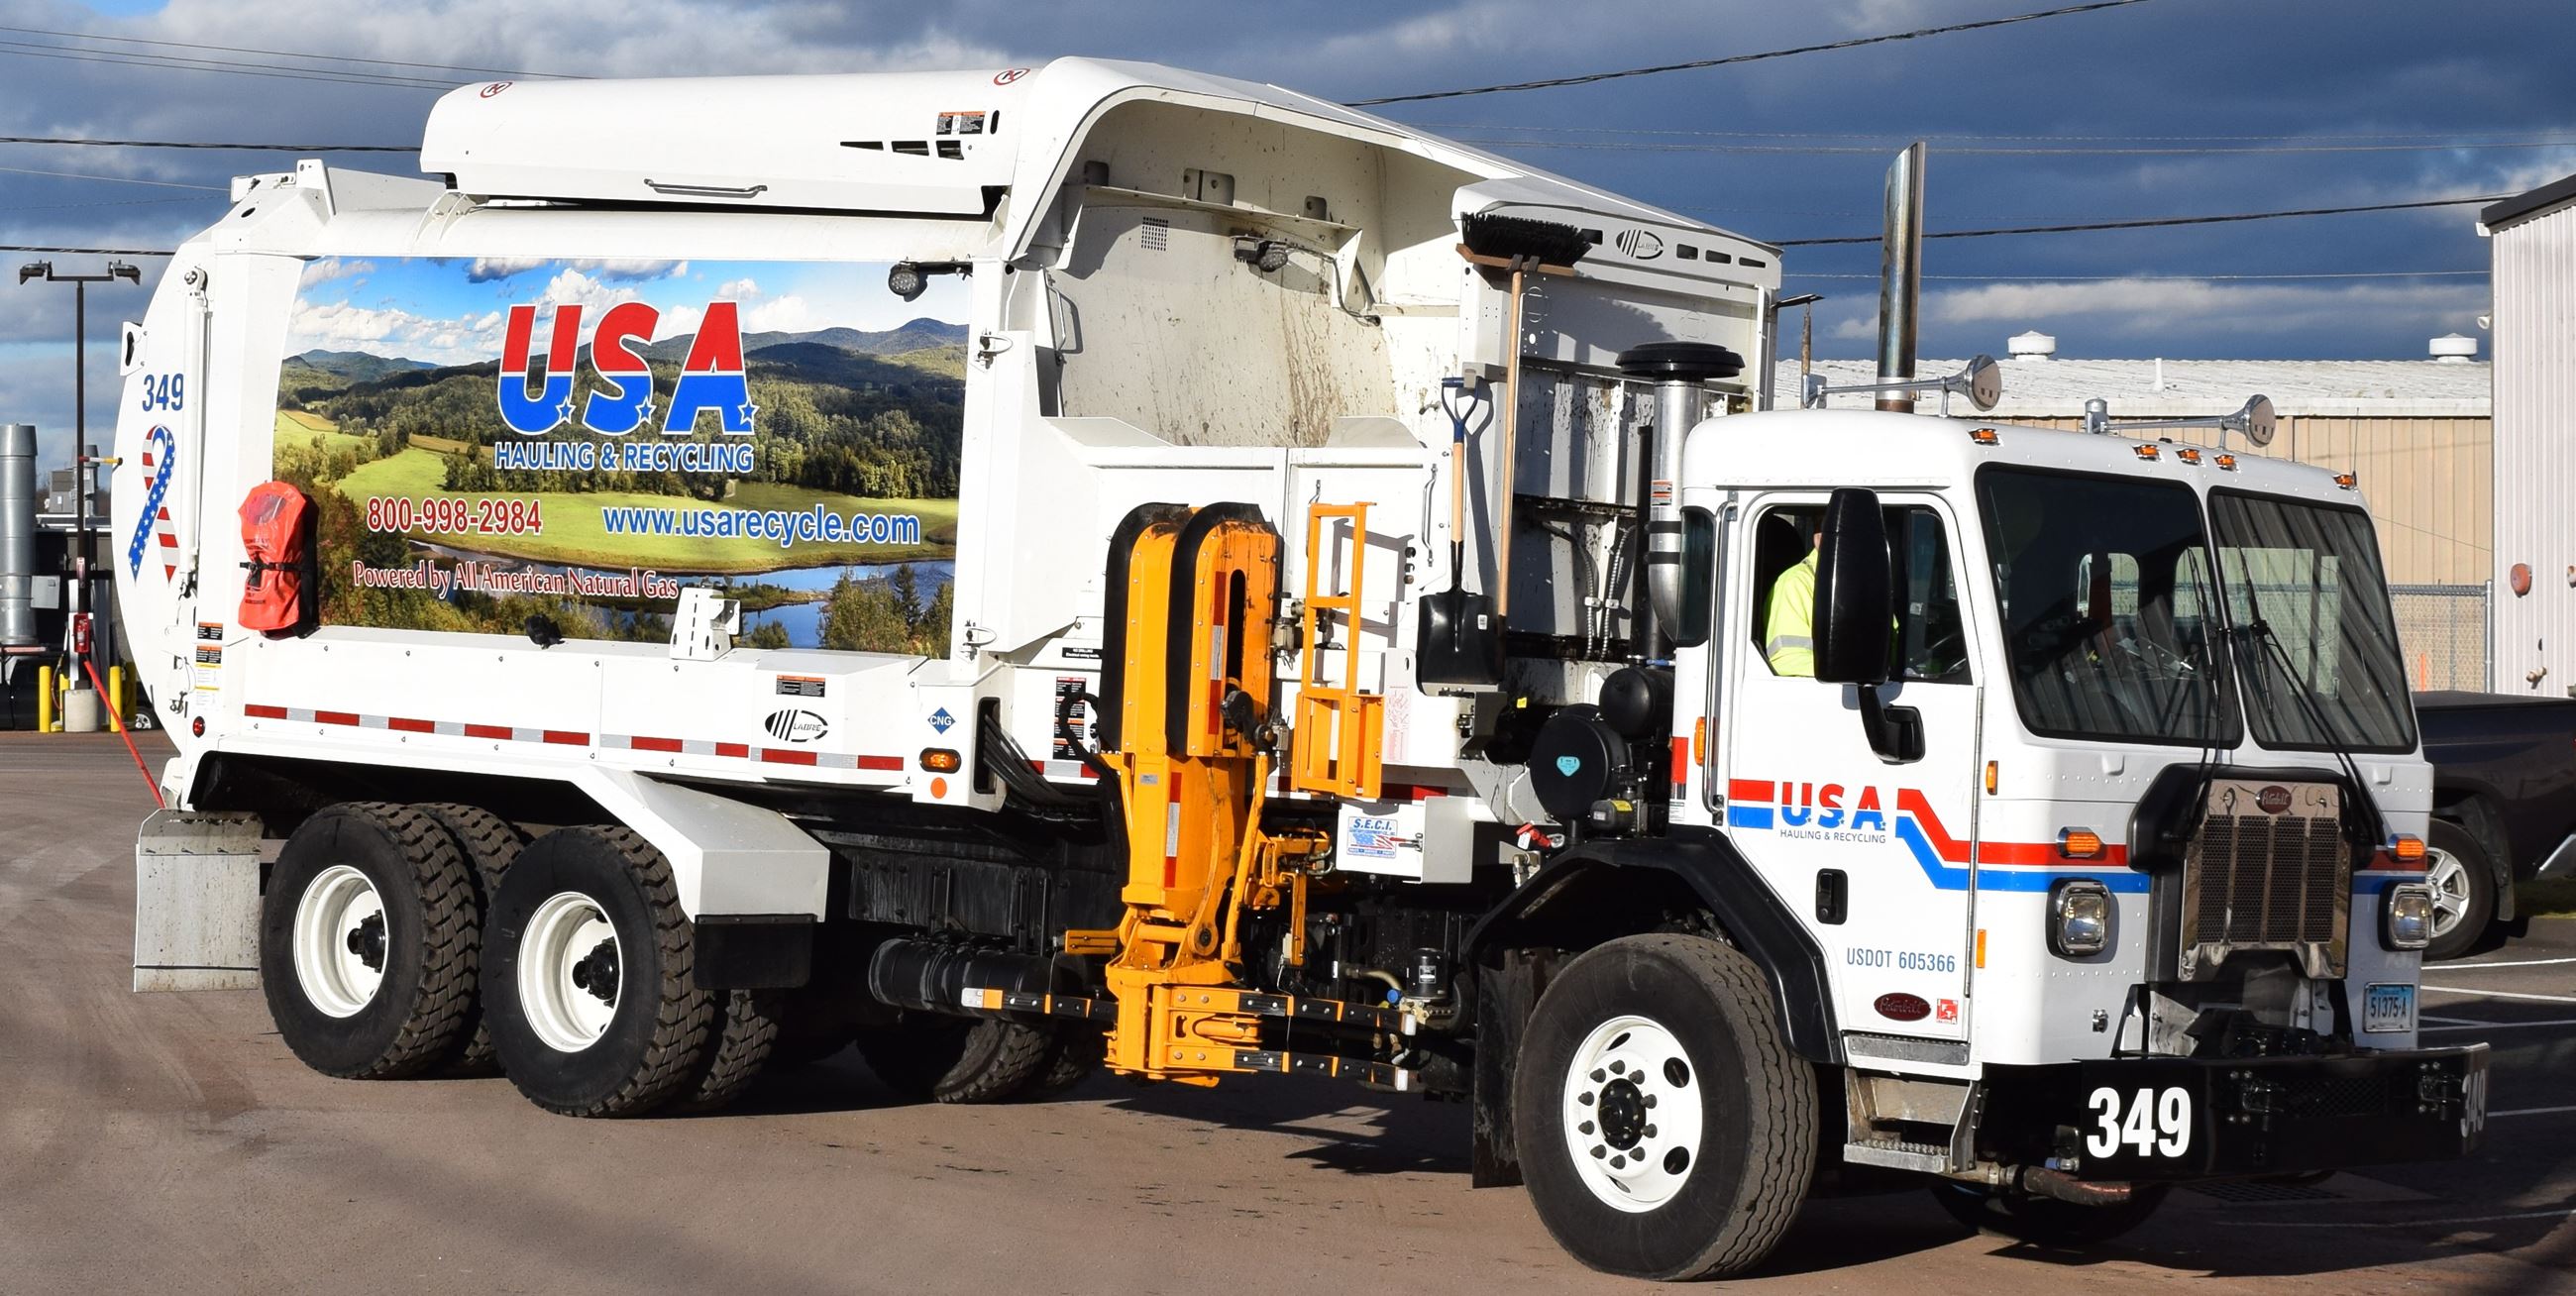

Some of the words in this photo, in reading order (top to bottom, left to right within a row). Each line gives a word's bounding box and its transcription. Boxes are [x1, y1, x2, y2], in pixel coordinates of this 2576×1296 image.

[497, 301, 760, 436] USA
[142, 373, 184, 412] 349
[495, 442, 594, 471] HAULING
[600, 443, 619, 471] &
[623, 444, 755, 474] RECYCLING
[367, 496, 543, 535] 800-998-2984
[602, 503, 921, 548] www.usarecycle.com
[353, 559, 426, 590] Powered
[429, 560, 451, 599] by
[453, 561, 478, 592] All
[482, 564, 566, 594] American
[567, 567, 639, 598] Natural
[642, 570, 679, 598] Gas
[929, 714, 953, 726] CNG
[1353, 818, 1393, 831] S.E.C.I.
[1780, 781, 1886, 832] USA
[1779, 829, 1822, 840] HAULING
[1824, 831, 1831, 841] &
[1834, 832, 1886, 844] RECYCLING
[1847, 947, 1892, 968] USDOT
[1898, 951, 1956, 973] 605366
[2087, 1086, 2192, 1158] 349
[2460, 1068, 2486, 1138] 349
